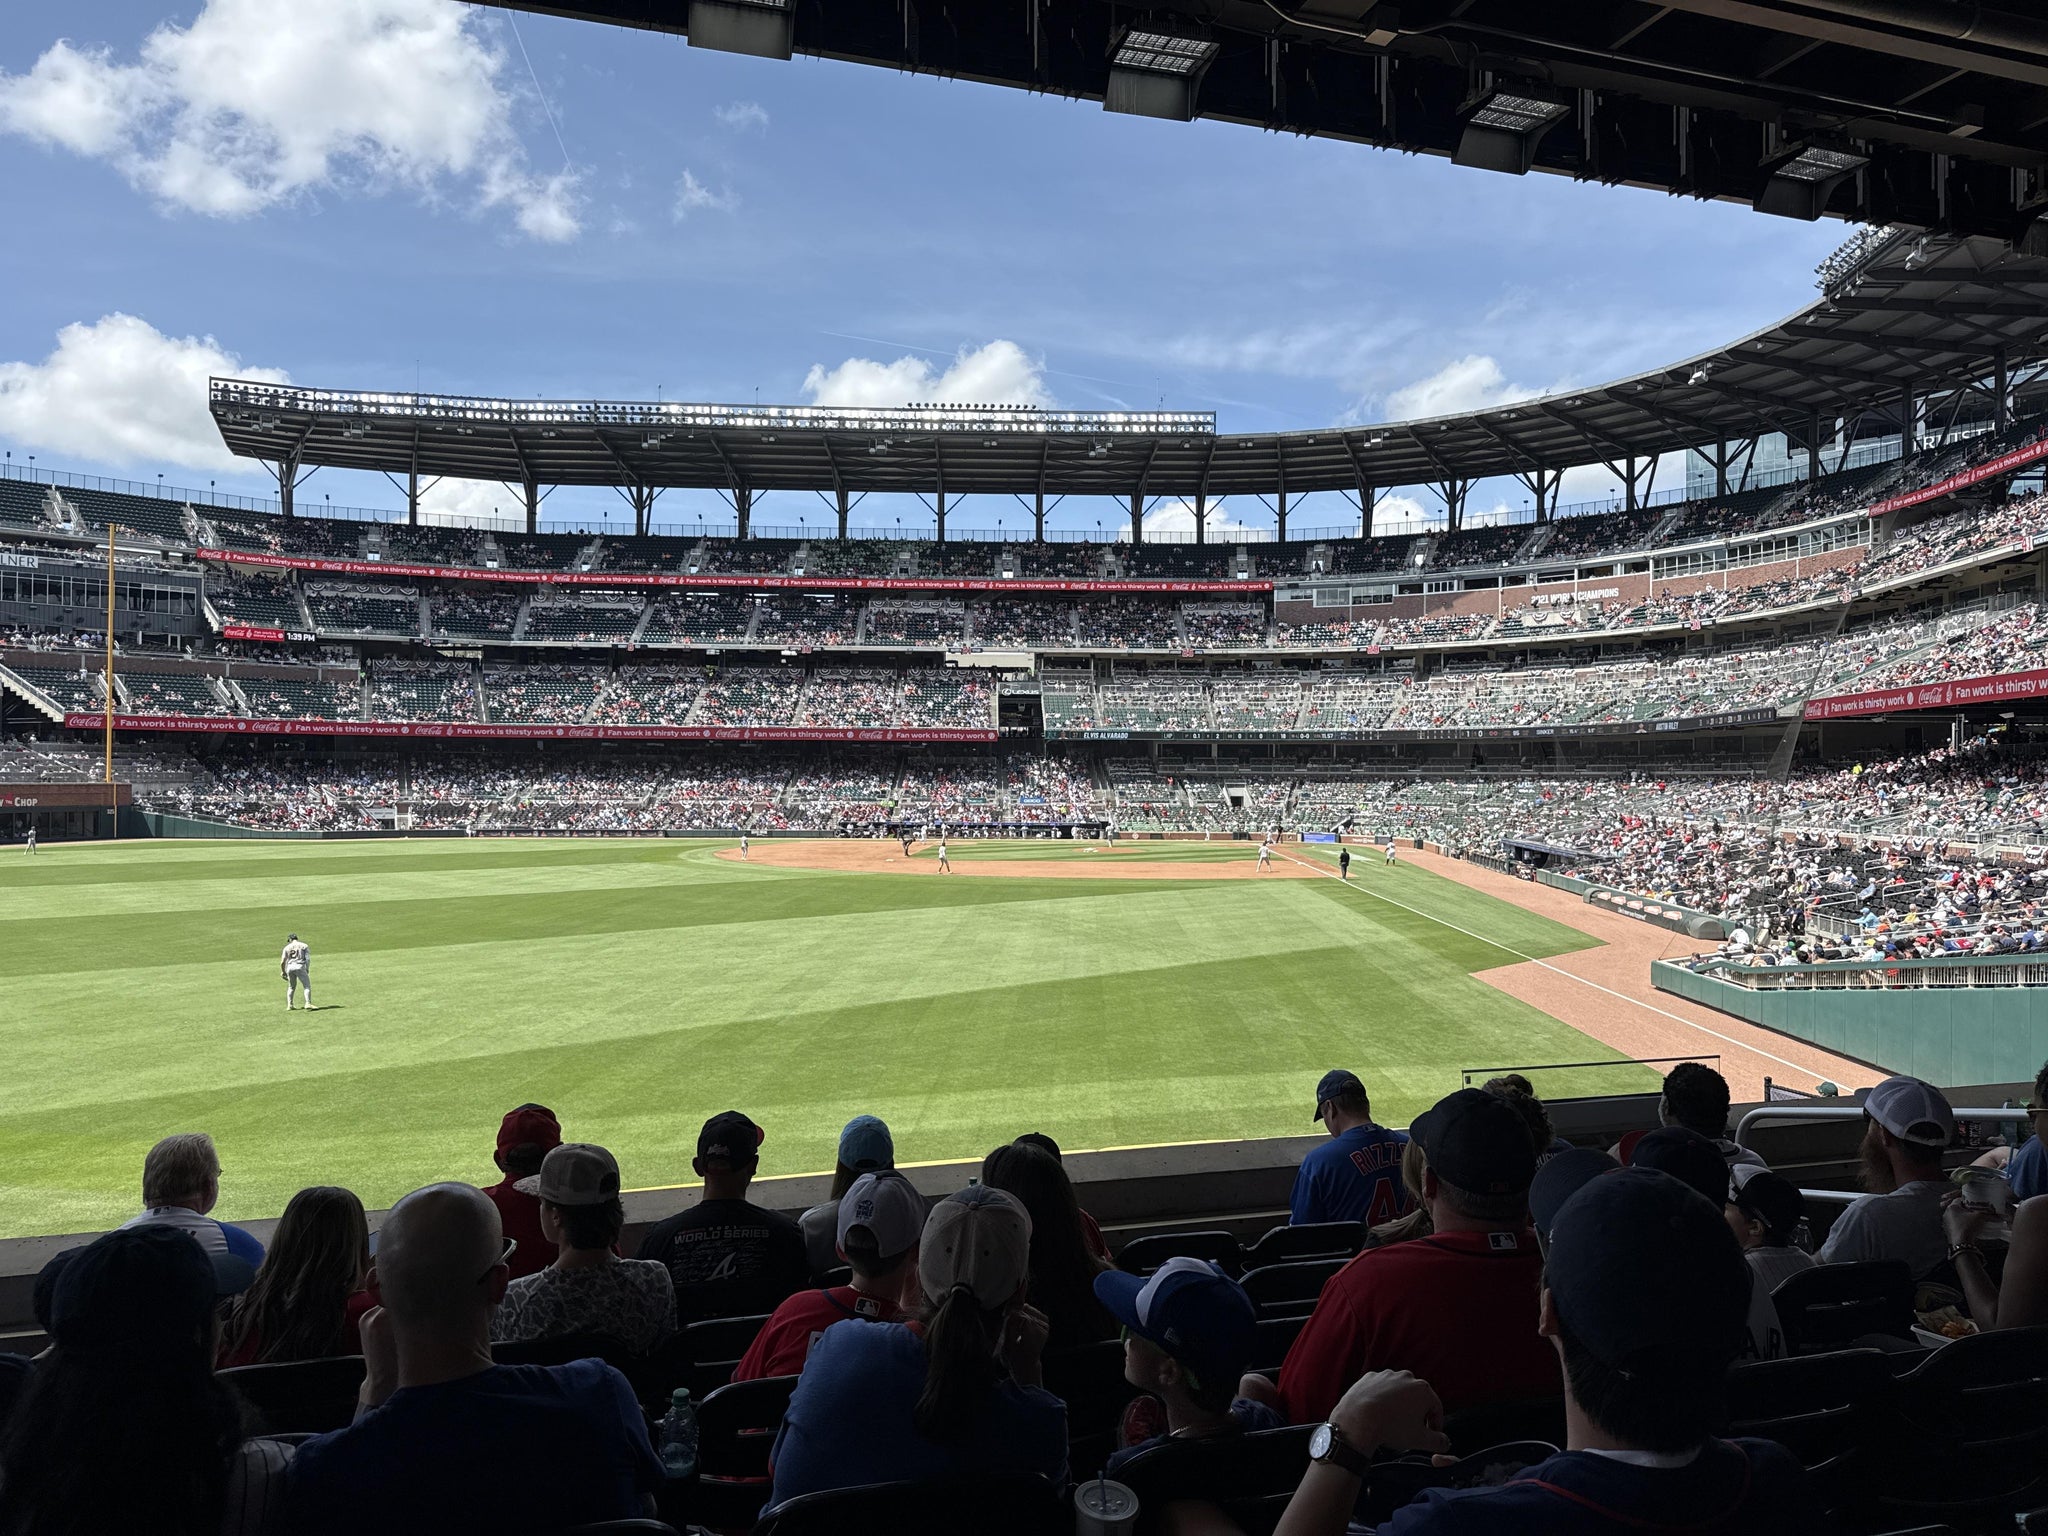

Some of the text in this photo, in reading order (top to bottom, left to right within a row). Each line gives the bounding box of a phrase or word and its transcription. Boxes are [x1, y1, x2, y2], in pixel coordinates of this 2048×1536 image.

[270, 558, 291, 566] thirsty
[390, 567, 410, 575] thirsty
[1578, 588, 1619, 600] CHAMPIONS
[1956, 687, 1971, 699] Fan
[1972, 683, 1994, 697] work
[1996, 681, 2004, 694] is
[2005, 678, 2037, 693] thirsty
[1918, 687, 1943, 705] Coca-Cola
[1831, 696, 1905, 712] Fan work is thirsty work
[120, 719, 234, 730] Fan work is thirsty work
[295, 724, 311, 732] Fan
[344, 725, 374, 735] thirsty
[505, 728, 532, 738] thirsty
[645, 729, 652, 737] is
[653, 730, 680, 739] thirsty
[798, 731, 823, 740] thirsty
[940, 732, 965, 741] thirsty
[14, 797, 38, 807] CHOP
[674, 1229, 721, 1245] WORLD
[724, 1229, 770, 1239] SERIES
